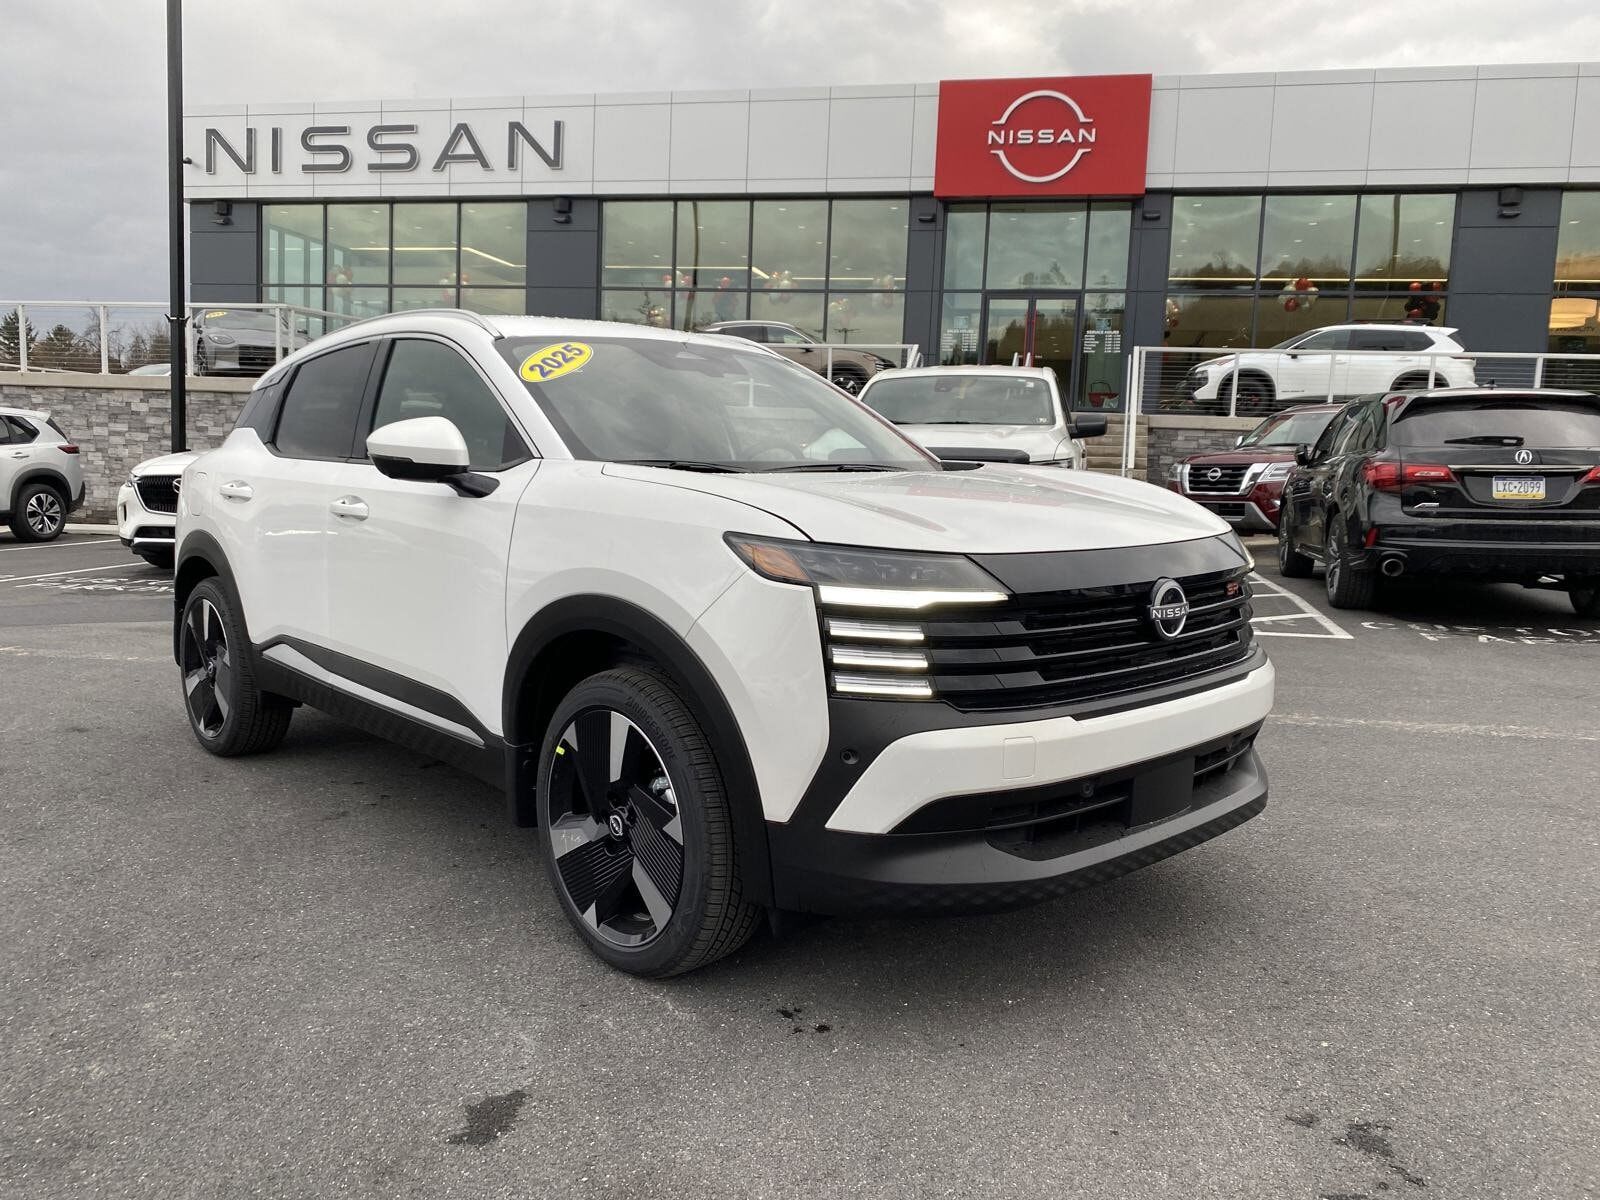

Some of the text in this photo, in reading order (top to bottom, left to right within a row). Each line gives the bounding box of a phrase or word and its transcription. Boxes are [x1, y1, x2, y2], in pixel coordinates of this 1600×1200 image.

[205, 120, 563, 174] NISSAN
[987, 127, 1096, 145] NISSAN
[528, 344, 584, 378] 2025
